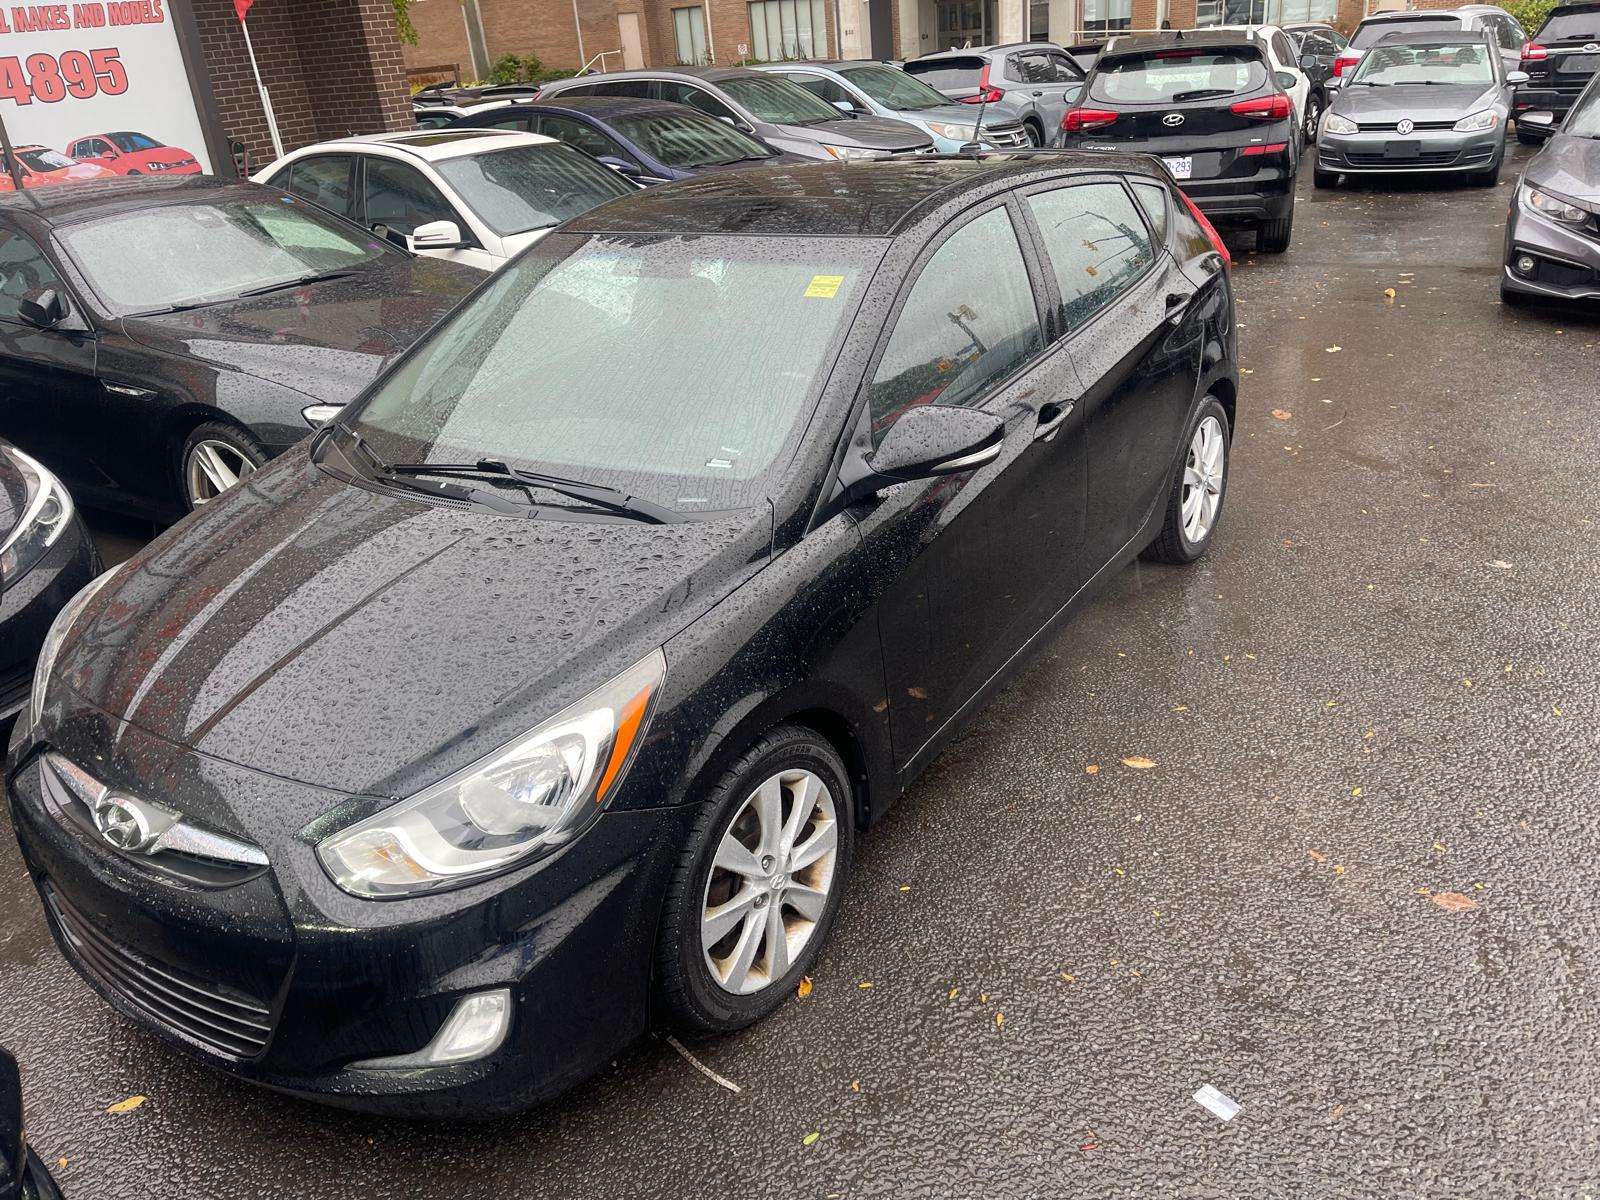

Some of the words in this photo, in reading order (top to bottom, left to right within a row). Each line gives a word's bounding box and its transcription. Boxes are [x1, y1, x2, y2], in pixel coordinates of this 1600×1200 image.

[11, 4, 71, 33] MAKES
[73, 2, 105, 28] AND
[108, 0, 164, 26] MODELS
[0, 47, 129, 106] 4895
